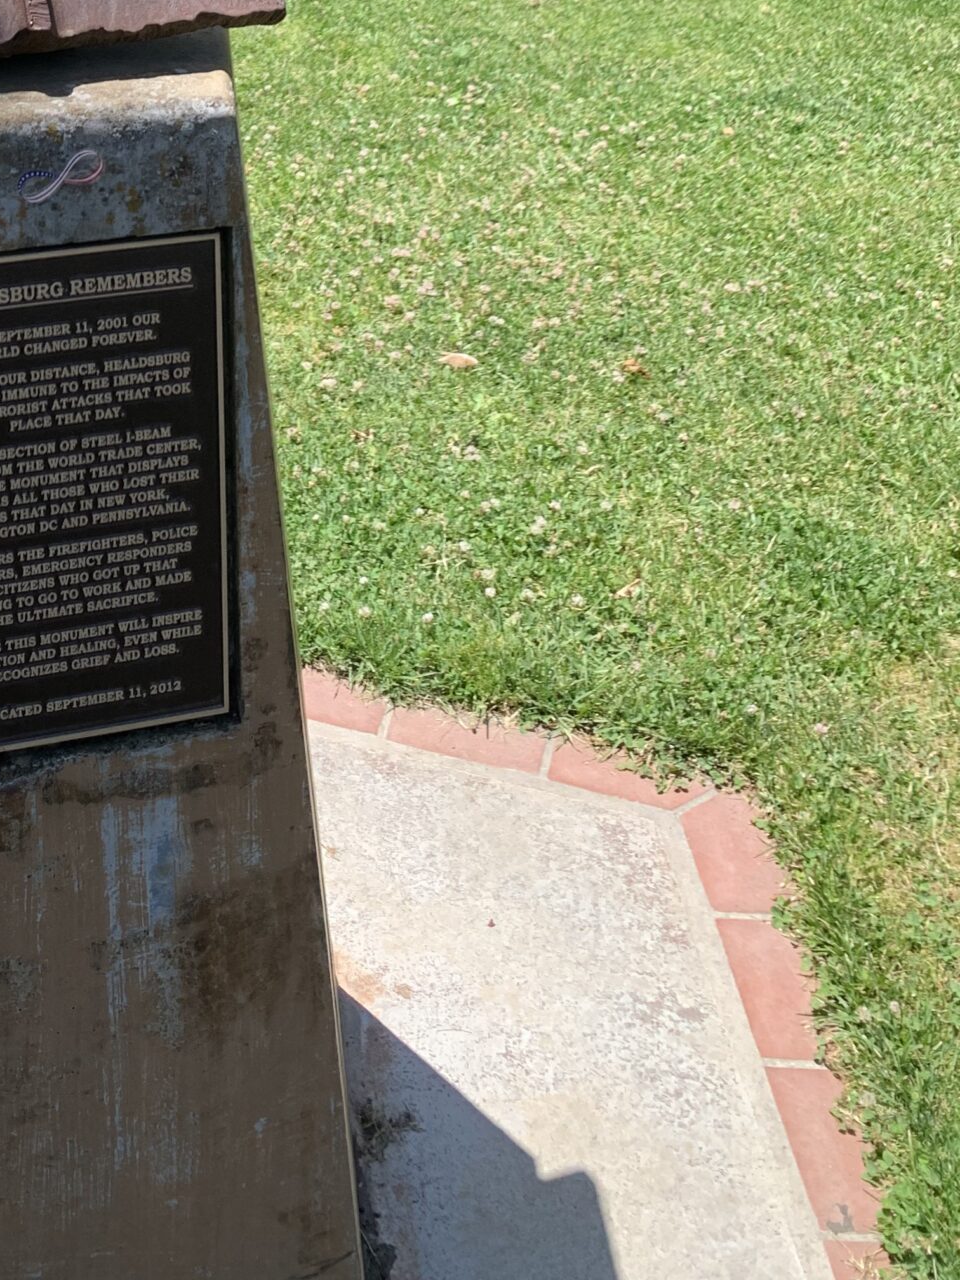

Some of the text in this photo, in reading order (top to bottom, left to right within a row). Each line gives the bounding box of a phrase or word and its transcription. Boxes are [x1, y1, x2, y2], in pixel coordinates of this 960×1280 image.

[71, 267, 192, 294] REMEMBERS
[75, 322, 93, 335] 11,
[97, 317, 128, 330] 2001
[133, 313, 160, 326] OUR
[24, 336, 88, 356] CHANGED
[92, 329, 157, 350] FOREVER.
[0, 371, 26, 386] OUR
[30, 363, 100, 383] DISTANCE,
[104, 352, 191, 373] HEALDSBURG
[1, 385, 57, 402] IMMUNE
[61, 382, 78, 393] TO
[83, 377, 109, 390] THE
[113, 371, 169, 387] IMPACTS
[173, 367, 191, 379] OF
[52, 393, 112, 411] ATTACKS
[116, 388, 151, 402] THAT
[154, 382, 192, 396] TOOK
[10, 406, 125, 432] PLACE THAT DAY.
[0, 442, 56, 461] SECTION
[60, 439, 78, 452] OF
[81, 432, 122, 449] STEEL
[126, 426, 172, 444] I-BEAM
[17, 459, 44, 473] THE
[48, 452, 95, 469] WORLD
[99, 446, 143, 461] TRADE
[146, 438, 202, 455] CENTER,
[10, 468, 86, 489] MONUMENT
[90, 465, 124, 479] THAT
[128, 455, 189, 473] DISPLAYS
[13, 490, 38, 504] ALL
[42, 485, 85, 500] THOSE
[89, 479, 119, 494] WHO
[123, 475, 157, 489] LOST
[160, 469, 200, 484] THEIR
[11, 506, 46, 521] THAT
[51, 501, 76, 515] DAY
[79, 499, 93, 511] IN
[97, 495, 126, 508] NEW
[129, 489, 170, 504] YORK,
[40, 519, 58, 532] DC
[61, 515, 88, 529] AND
[92, 502, 191, 524] PENNSYLVANIA.
[18, 547, 45, 562] THE
[49, 533, 148, 557] FIREFIGHTERS,
[152, 525, 199, 543] POLICE
[22, 555, 104, 577] EMERGENCY
[107, 541, 192, 563] RESPONDERS
[59, 571, 89, 586] WHO
[93, 567, 120, 580] GOT
[123, 563, 140, 576] UP
[144, 558, 178, 573] THAT
[16, 596, 34, 608] TO
[38, 592, 57, 604] GO
[60, 588, 79, 601] TO
[83, 581, 122, 597] WORK
[125, 576, 151, 590] AND
[155, 571, 192, 587] MADE
[18, 604, 83, 623] ULTIMATE
[87, 592, 159, 613] SACRIFICE.
[5, 636, 37, 651] THIS
[40, 624, 115, 645] MONUMENT
[119, 619, 149, 633] WILL
[152, 610, 202, 628] INSPIRE
[29, 647, 57, 662] AND
[60, 638, 120, 656] HEALING,
[124, 632, 158, 647] EVEN
[161, 624, 202, 640] WHILE
[72, 655, 111, 670] GRIEF
[114, 649, 141, 664] AND
[144, 642, 179, 659] LOSS.
[46, 690, 124, 713] SEPTEMBER
[129, 685, 147, 698] 11,
[151, 680, 182, 696] 2012
